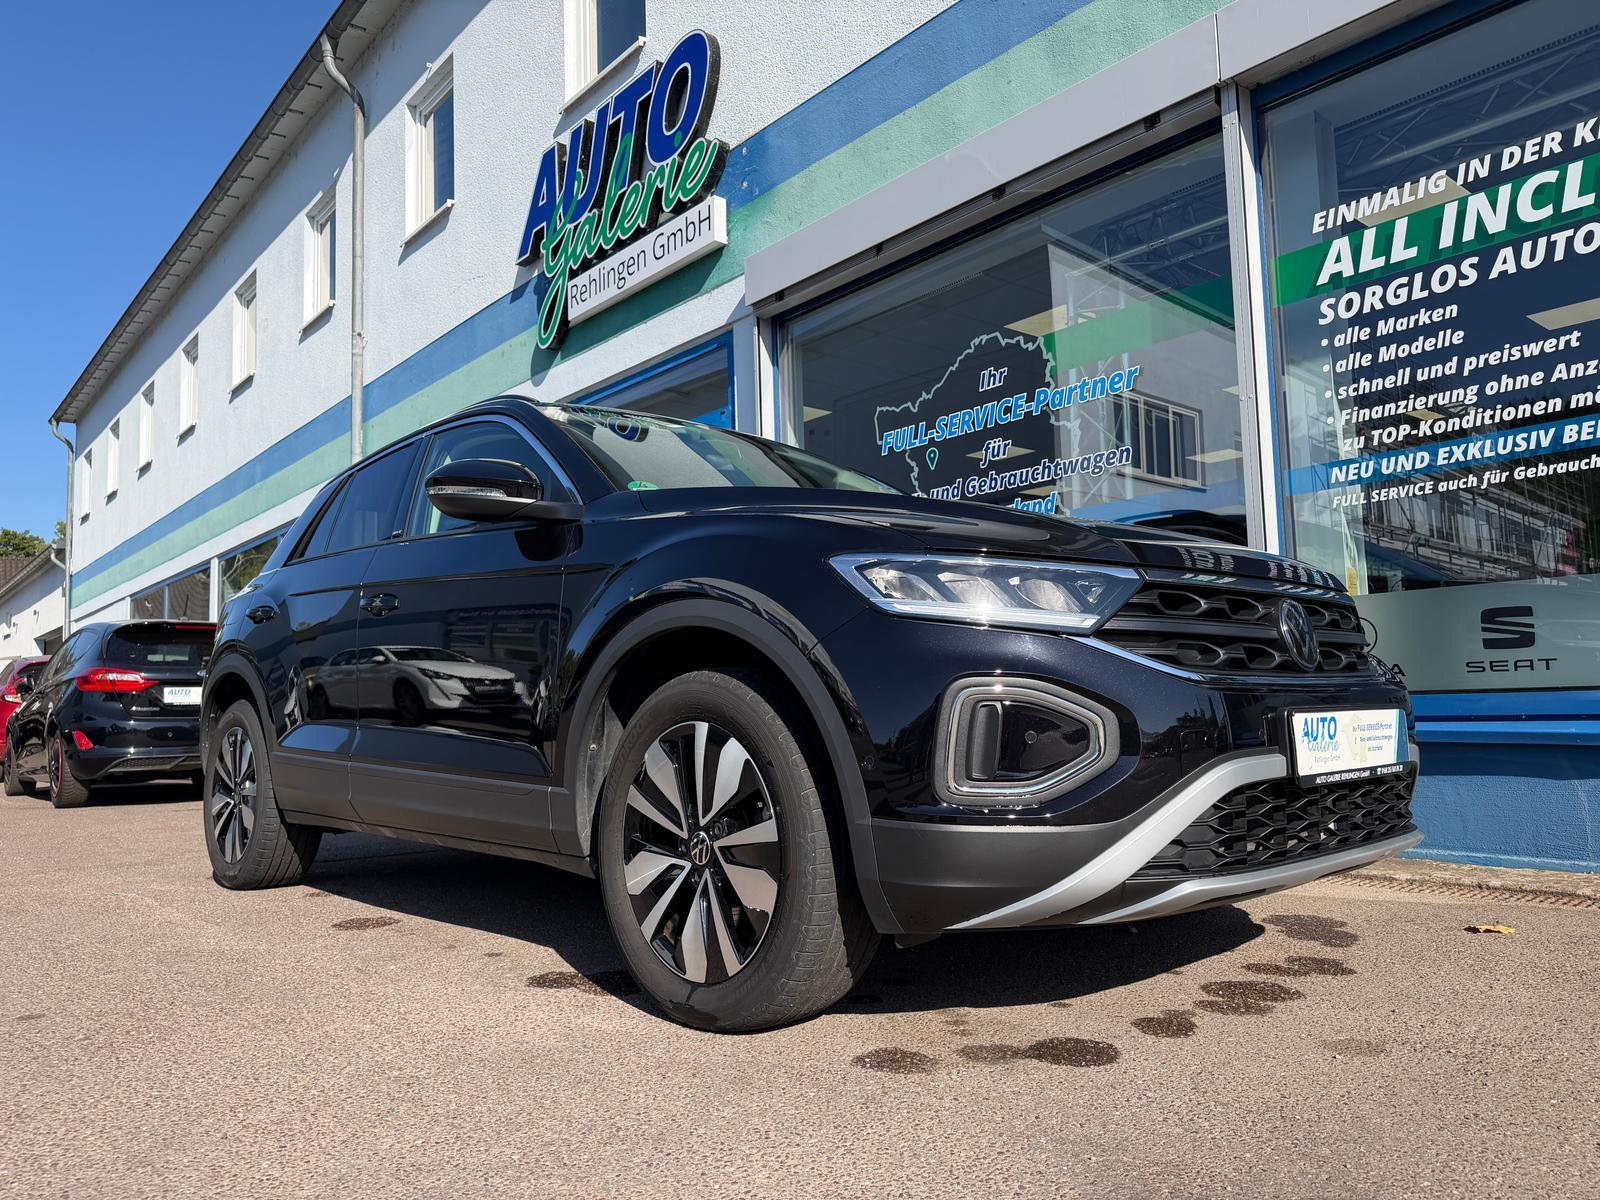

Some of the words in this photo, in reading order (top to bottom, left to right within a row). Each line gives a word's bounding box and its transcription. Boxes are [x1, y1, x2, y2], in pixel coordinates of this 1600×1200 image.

[516, 29, 712, 264] AUTO
[1312, 169, 1447, 234] EINMALIG
[1456, 154, 1491, 186] IN
[1500, 131, 1563, 173] DER
[1573, 116, 1600, 147] K
[537, 131, 719, 349] Galerie
[1315, 216, 1419, 287] ALL
[1438, 159, 1596, 250] INCL
[569, 249, 647, 309] Rehlingen
[652, 204, 712, 263] GmbH
[1318, 256, 1480, 326] SORGLOS
[1488, 221, 1600, 280] AUTO
[1333, 325, 1371, 347] alle
[1376, 303, 1458, 337] Marken
[1335, 350, 1372, 373] alle
[1377, 328, 1465, 363] Modelle
[979, 366, 1008, 393] Ihr
[1337, 367, 1410, 400] schnell
[1416, 356, 1458, 382] und
[1462, 329, 1582, 377] preiswert
[1340, 383, 1480, 427] Finanzierung
[1485, 371, 1545, 396] ohne
[1550, 359, 1600, 382] Anz
[881, 365, 1140, 456] FULL-SERVICE-Partner
[1342, 436, 1365, 451] zu
[1371, 396, 1562, 447] TOP-Konditionen
[965, 445, 1132, 498] Gebrauchtwagen
[980, 438, 1012, 469] für
[1330, 461, 1375, 484] NEU
[1381, 451, 1430, 475] UND
[1437, 427, 1556, 466] EXKLUSIV
[1332, 492, 1367, 508] FULL
[1371, 481, 1434, 502] SERVICE
[1437, 474, 1478, 493] auch
[1481, 468, 1509, 489] für
[1465, 657, 1558, 673] SEAT
[1303, 716, 1337, 742] AUTO
